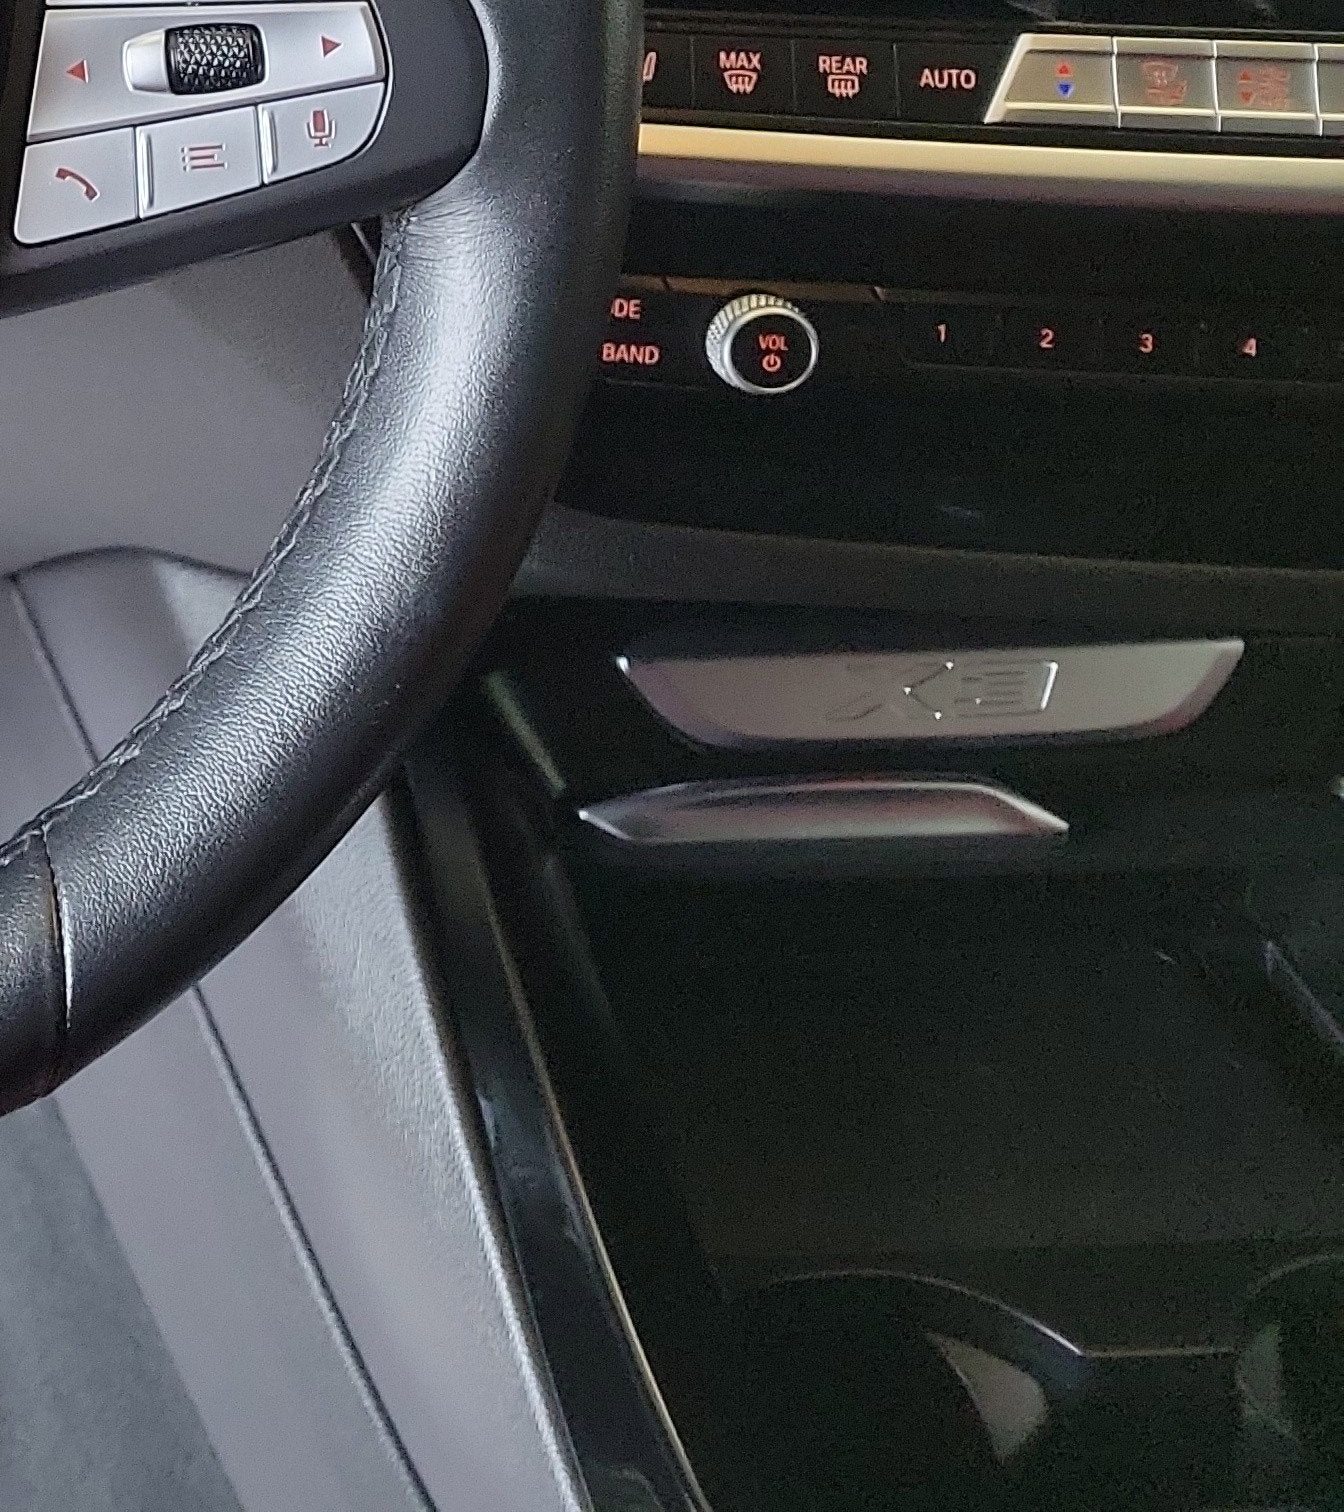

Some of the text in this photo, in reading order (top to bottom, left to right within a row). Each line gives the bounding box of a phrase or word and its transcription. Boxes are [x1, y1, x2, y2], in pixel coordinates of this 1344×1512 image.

[719, 51, 761, 70] MAX
[818, 55, 868, 76] REAR
[919, 68, 977, 90] AUTO
[611, 297, 642, 320] DE
[758, 334, 790, 352] VOL
[936, 323, 948, 344] 1
[1039, 328, 1055, 350] 2
[1139, 333, 1155, 354] 3
[602, 342, 660, 366] BAND
[1242, 337, 1259, 358] 4
[824, 657, 1060, 722] X3
